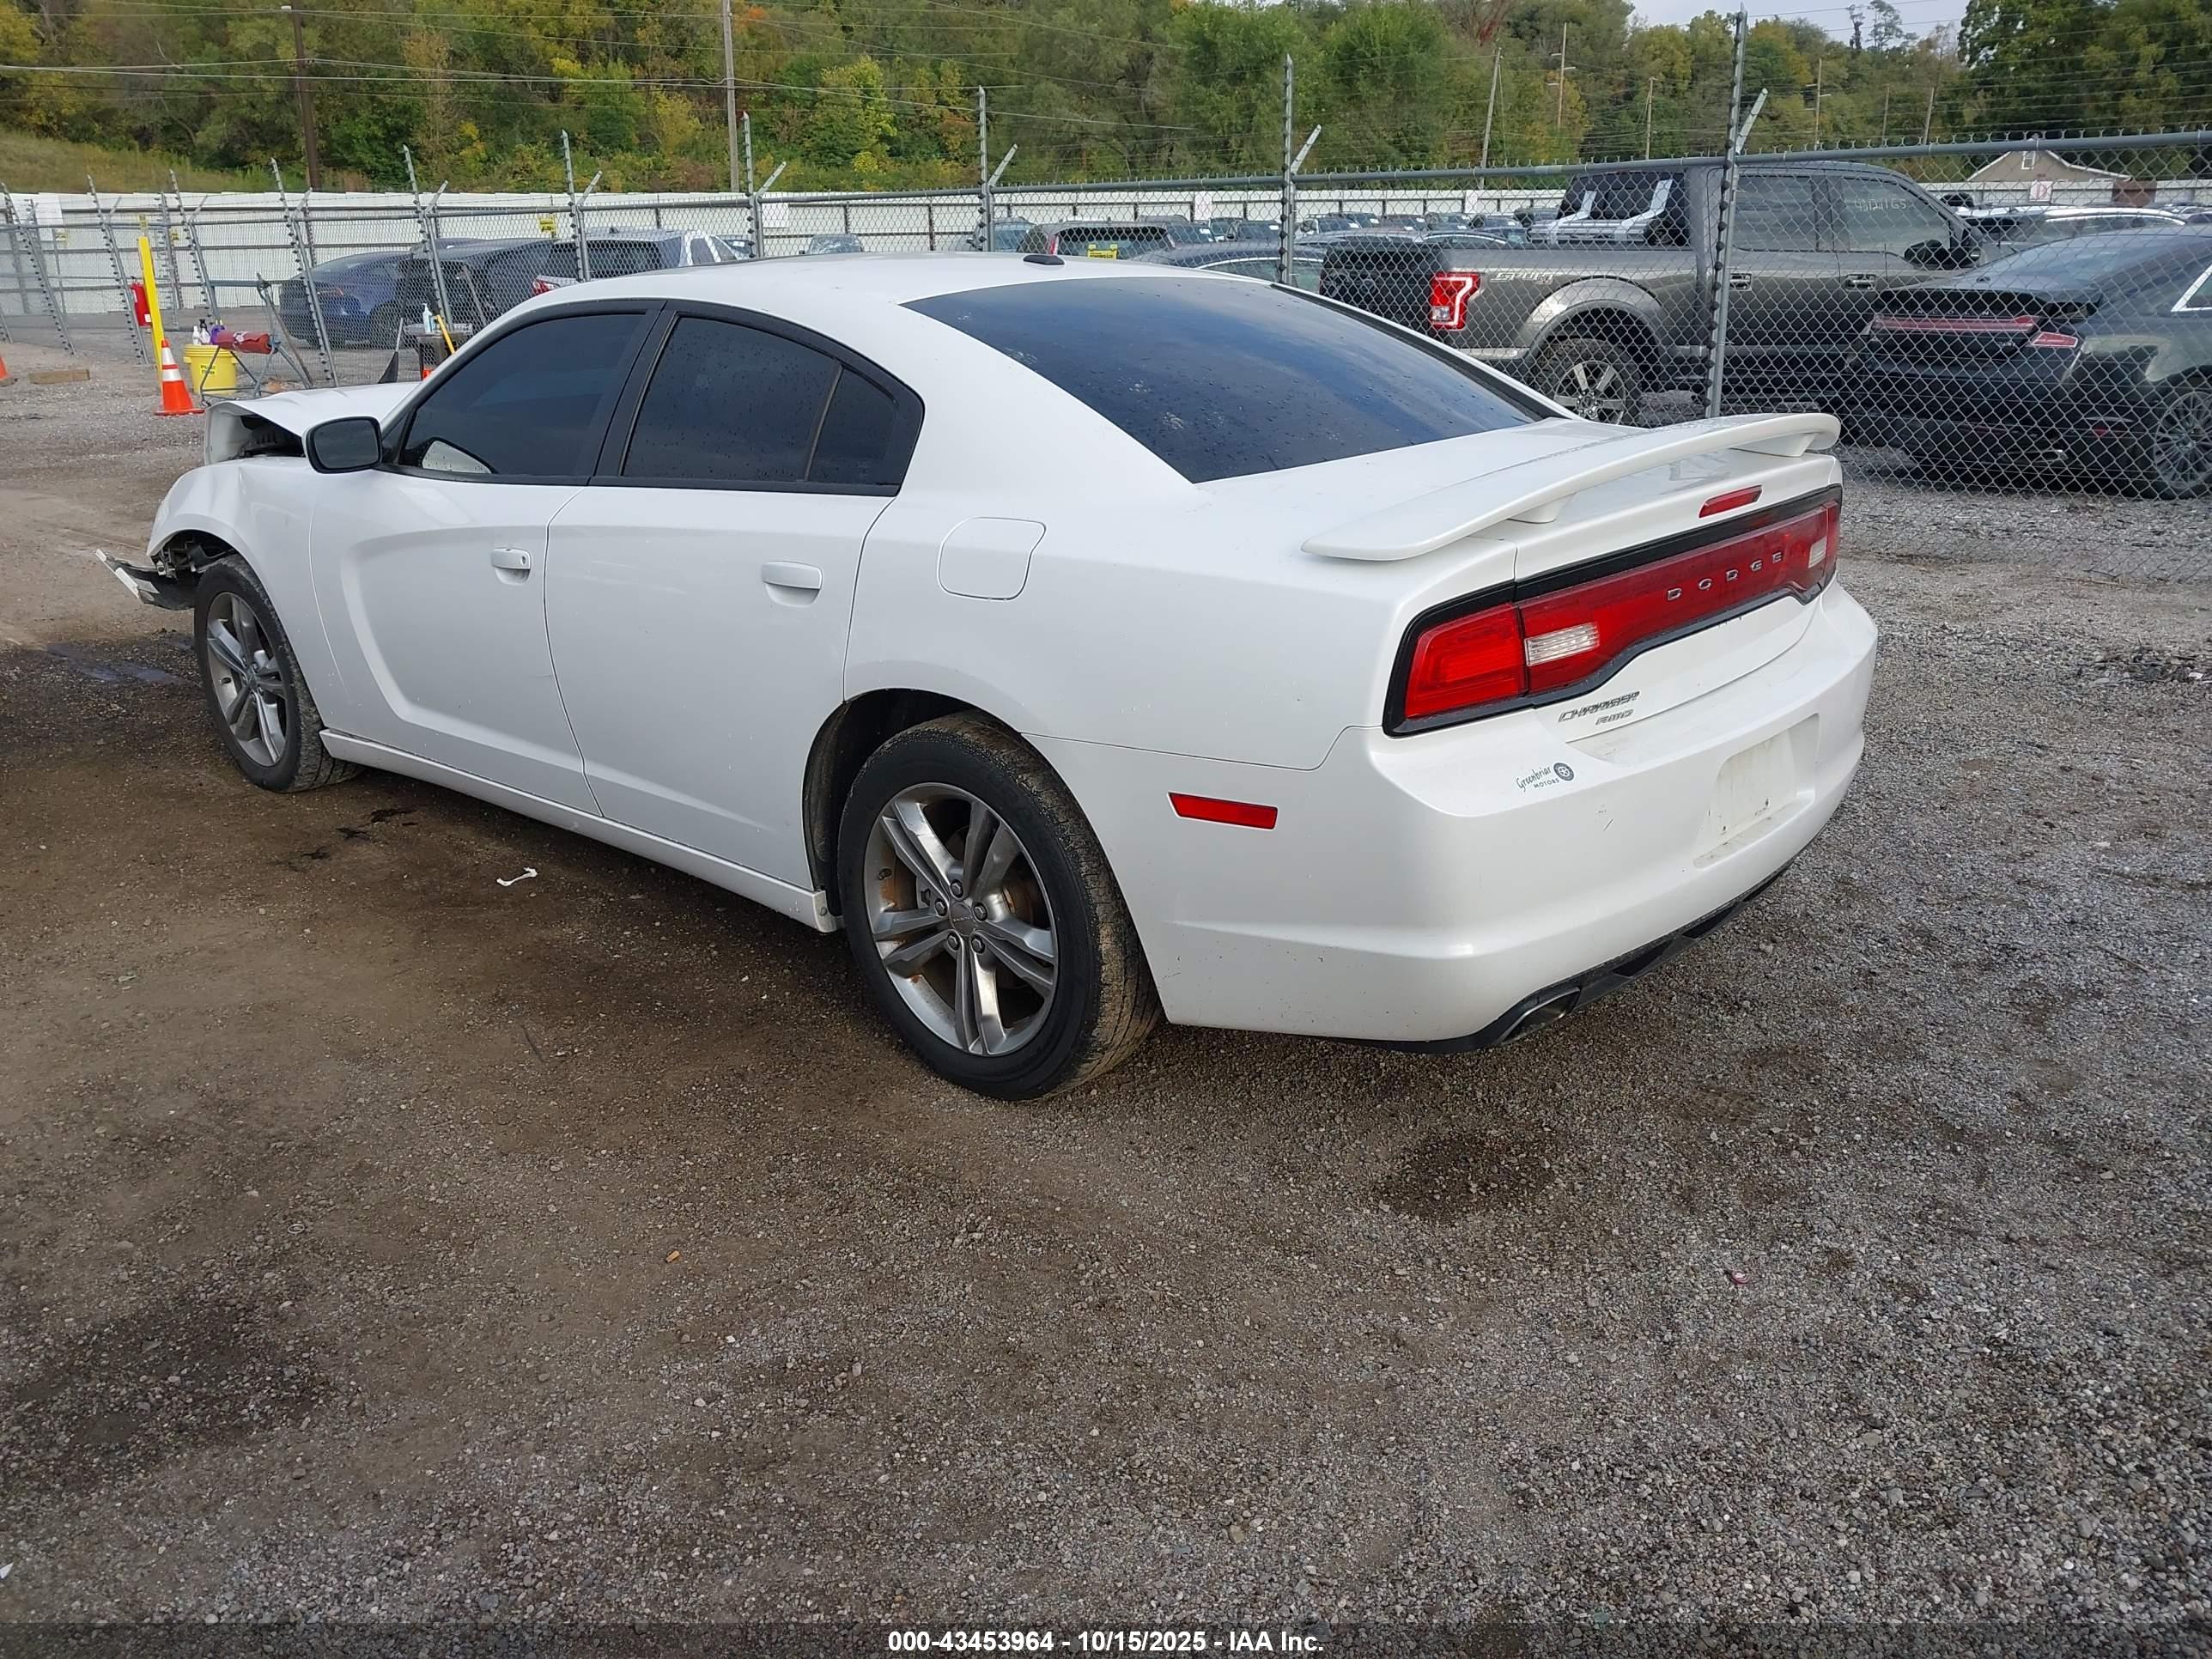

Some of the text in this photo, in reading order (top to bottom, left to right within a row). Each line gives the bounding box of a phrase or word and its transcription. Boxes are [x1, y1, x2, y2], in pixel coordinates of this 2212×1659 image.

[1667, 551, 1784, 601] DODGE
[1558, 690, 1641, 723] CHARGER
[1516, 766, 1552, 793] Greenbriar
[1534, 777, 1560, 788] MOTORS
